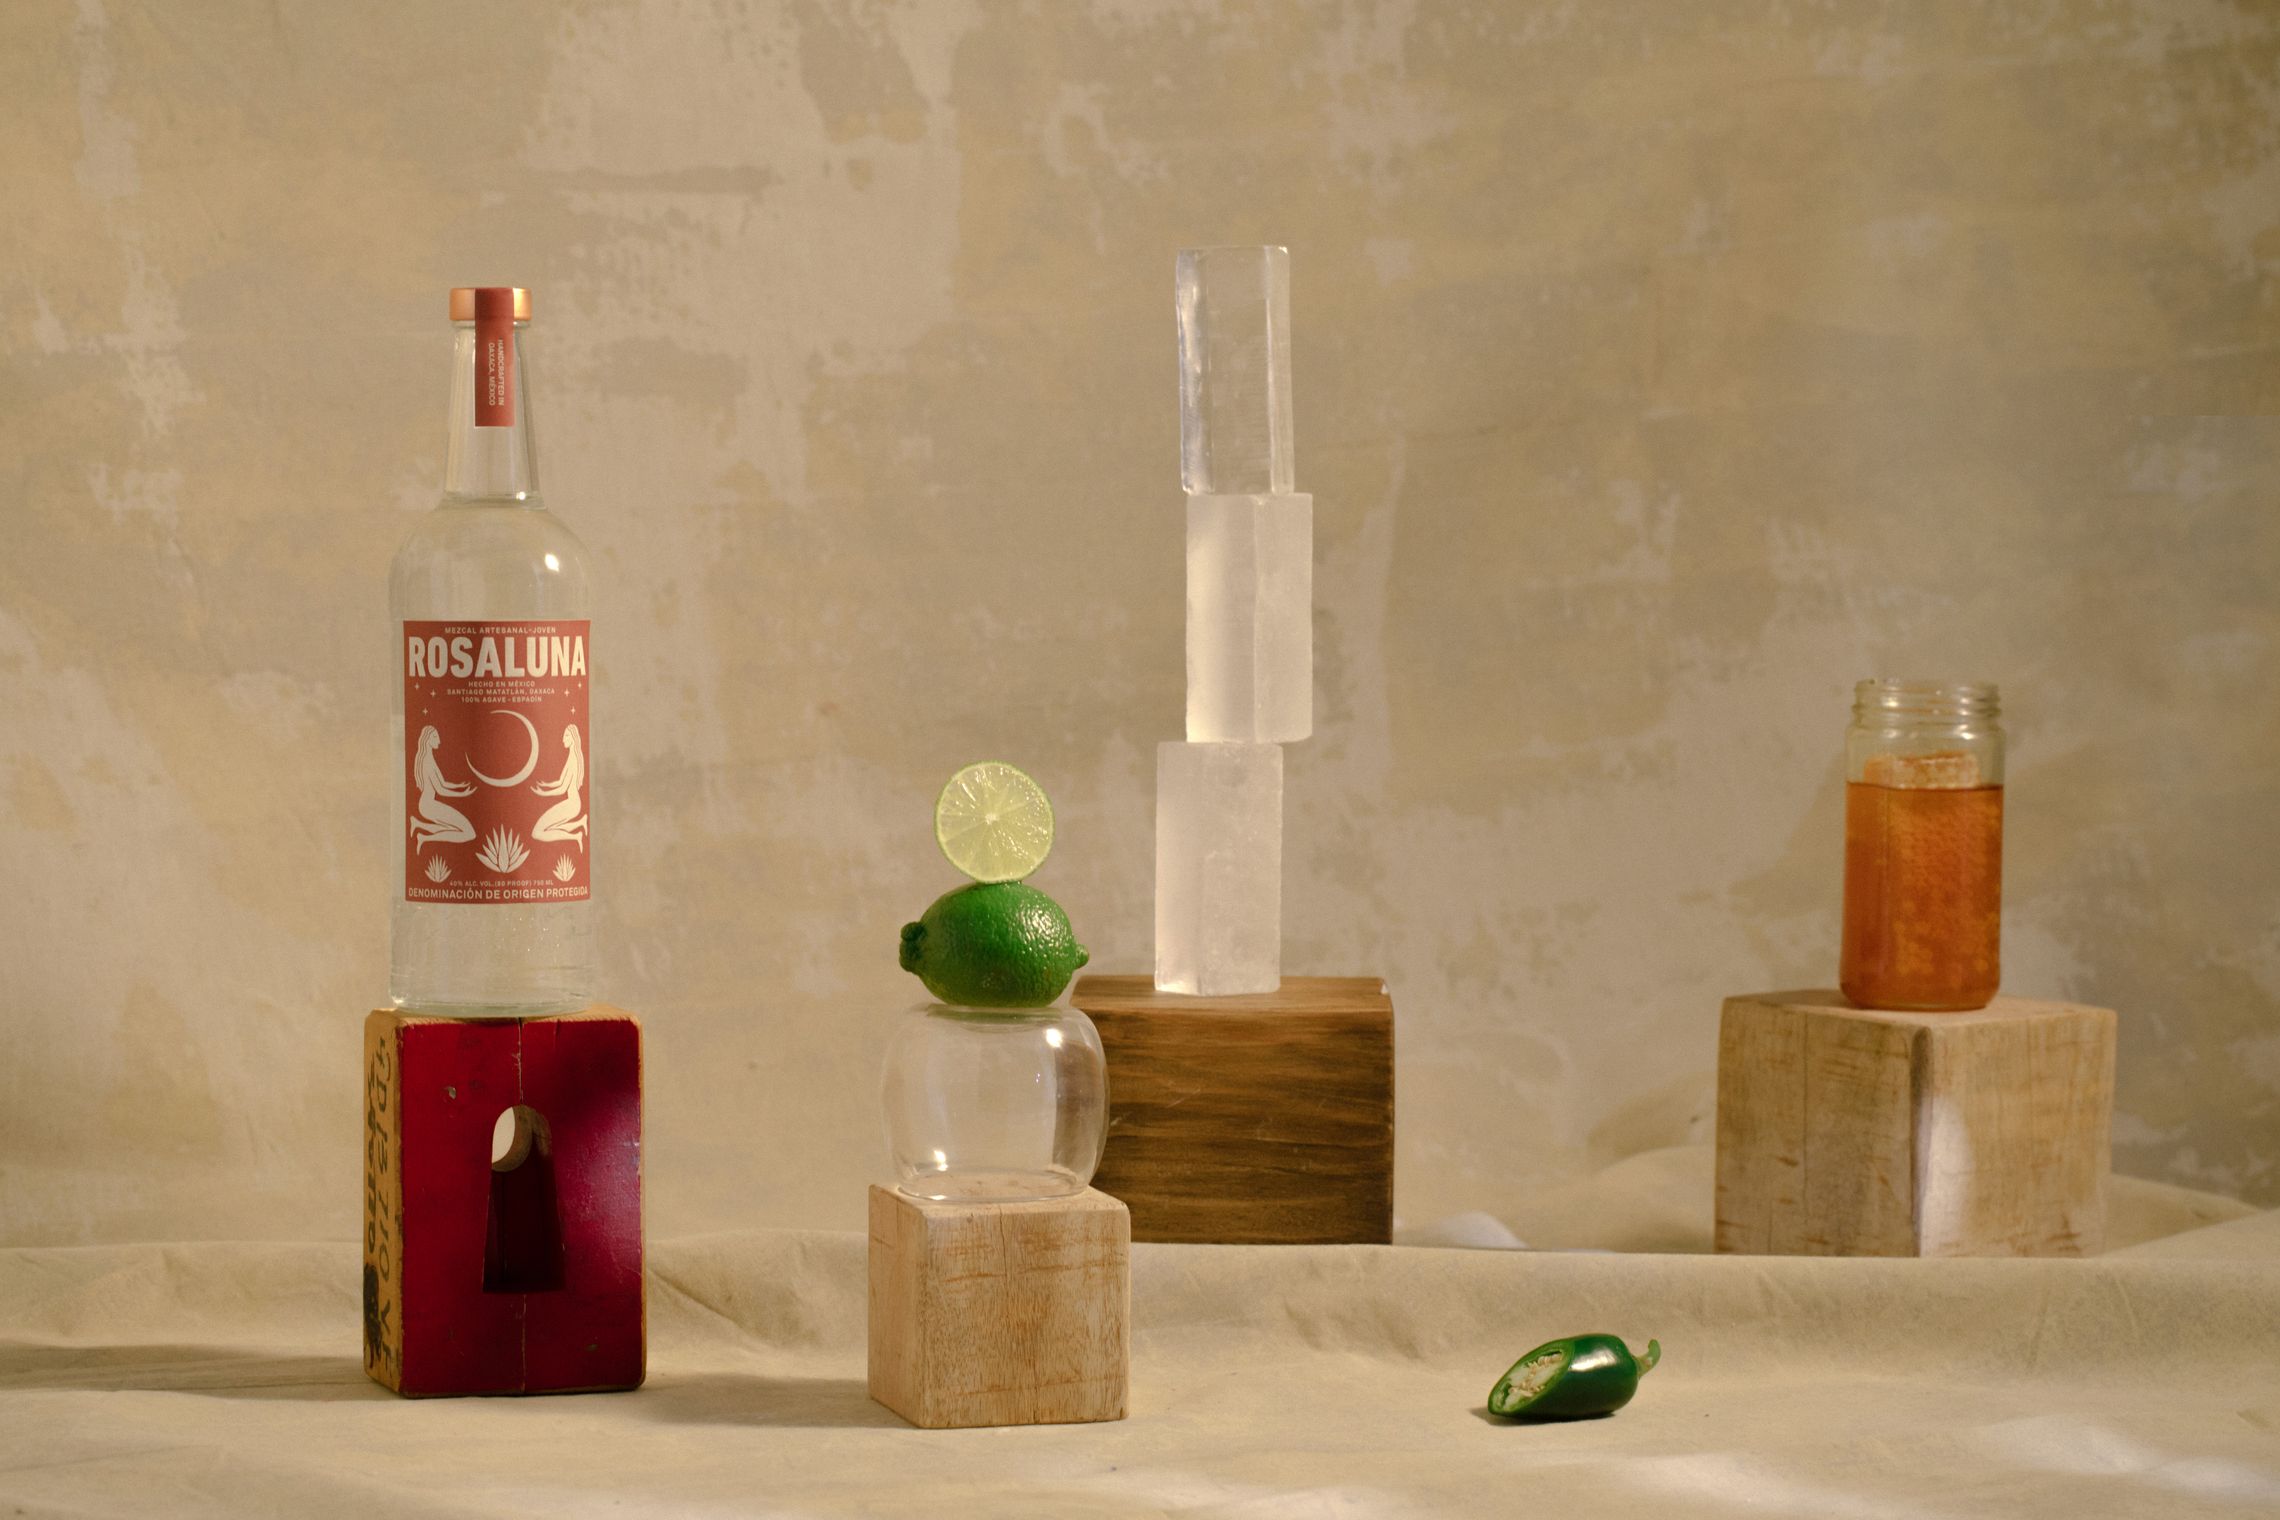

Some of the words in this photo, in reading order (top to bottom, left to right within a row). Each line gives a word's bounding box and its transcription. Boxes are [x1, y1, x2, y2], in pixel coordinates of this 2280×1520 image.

[408, 635, 586, 678] ROSALUNA
[408, 887, 482, 899] DENOMINACIÓN
[485, 889, 500, 900] DE
[503, 889, 544, 900] ORIGEN
[546, 885, 588, 898] PROTEGIDA
